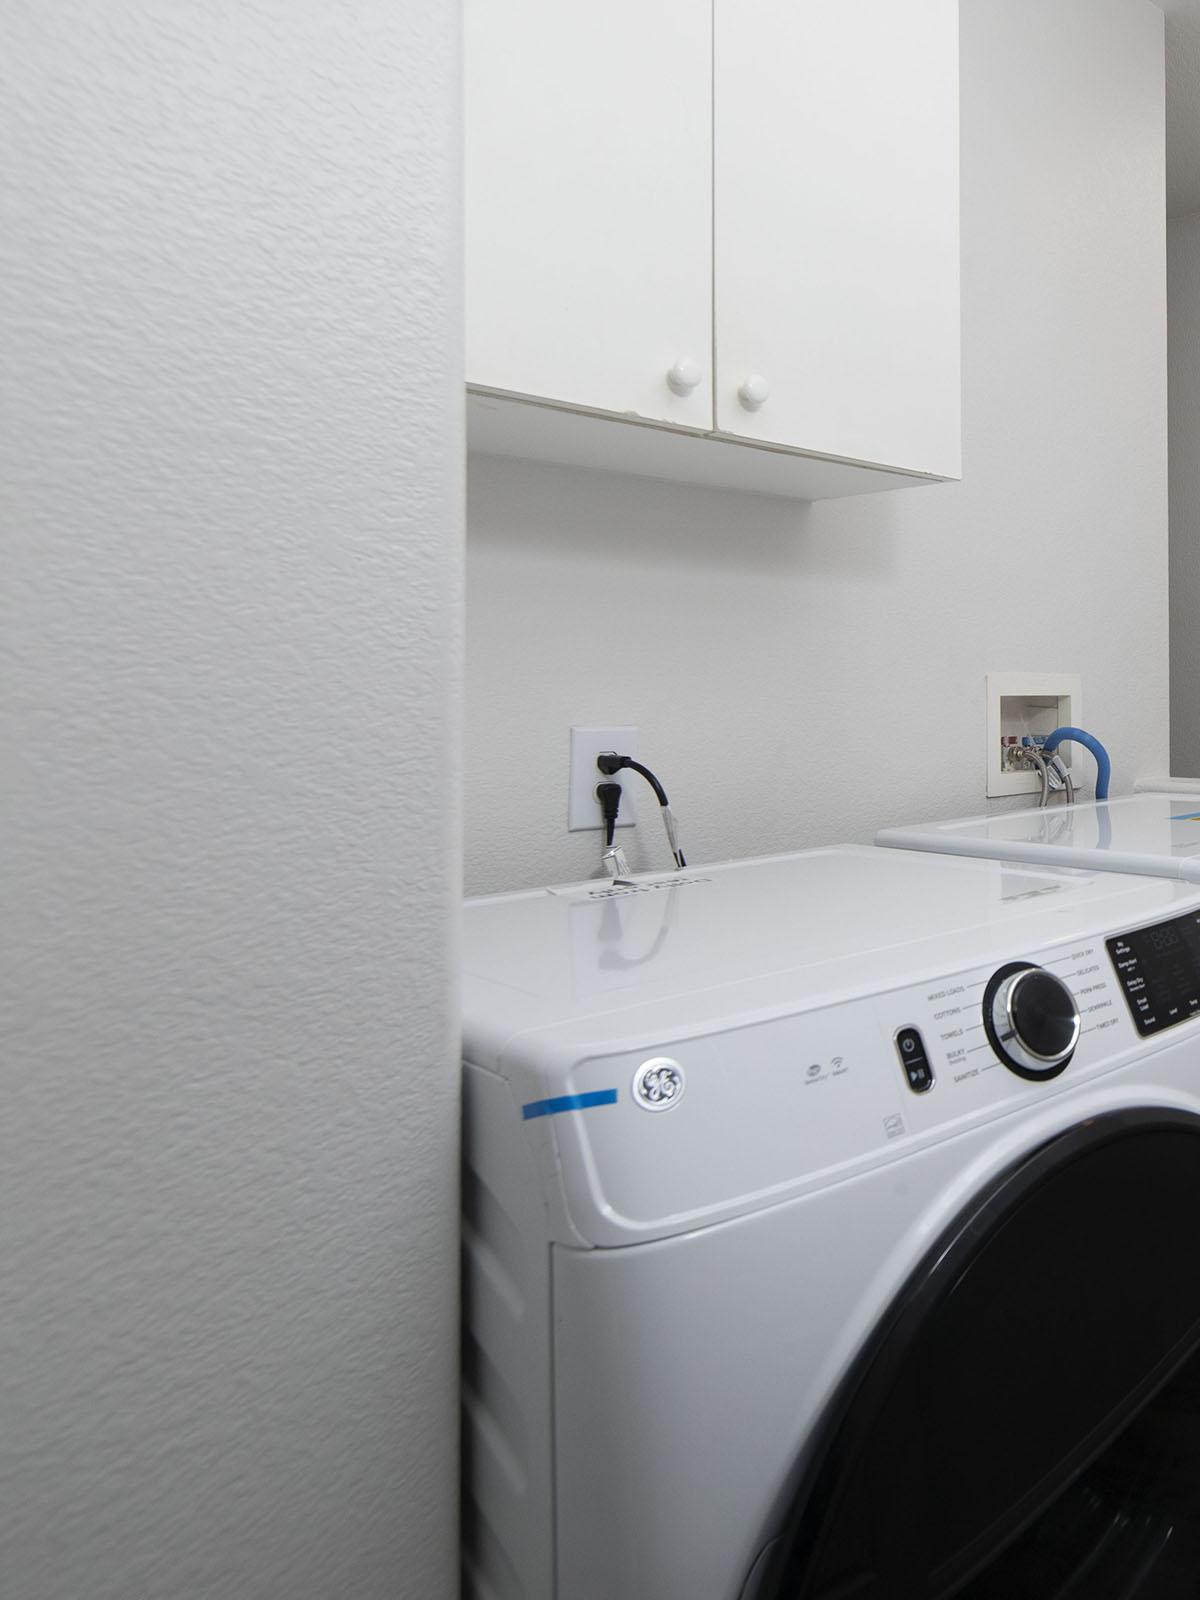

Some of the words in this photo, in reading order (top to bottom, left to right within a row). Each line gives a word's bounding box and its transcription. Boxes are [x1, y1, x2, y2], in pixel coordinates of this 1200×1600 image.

[946, 985, 965, 996] LOADS
[933, 1007, 962, 1020] COTTONS
[940, 1028, 964, 1040] TOWELS
[636, 1062, 682, 1106] GE
